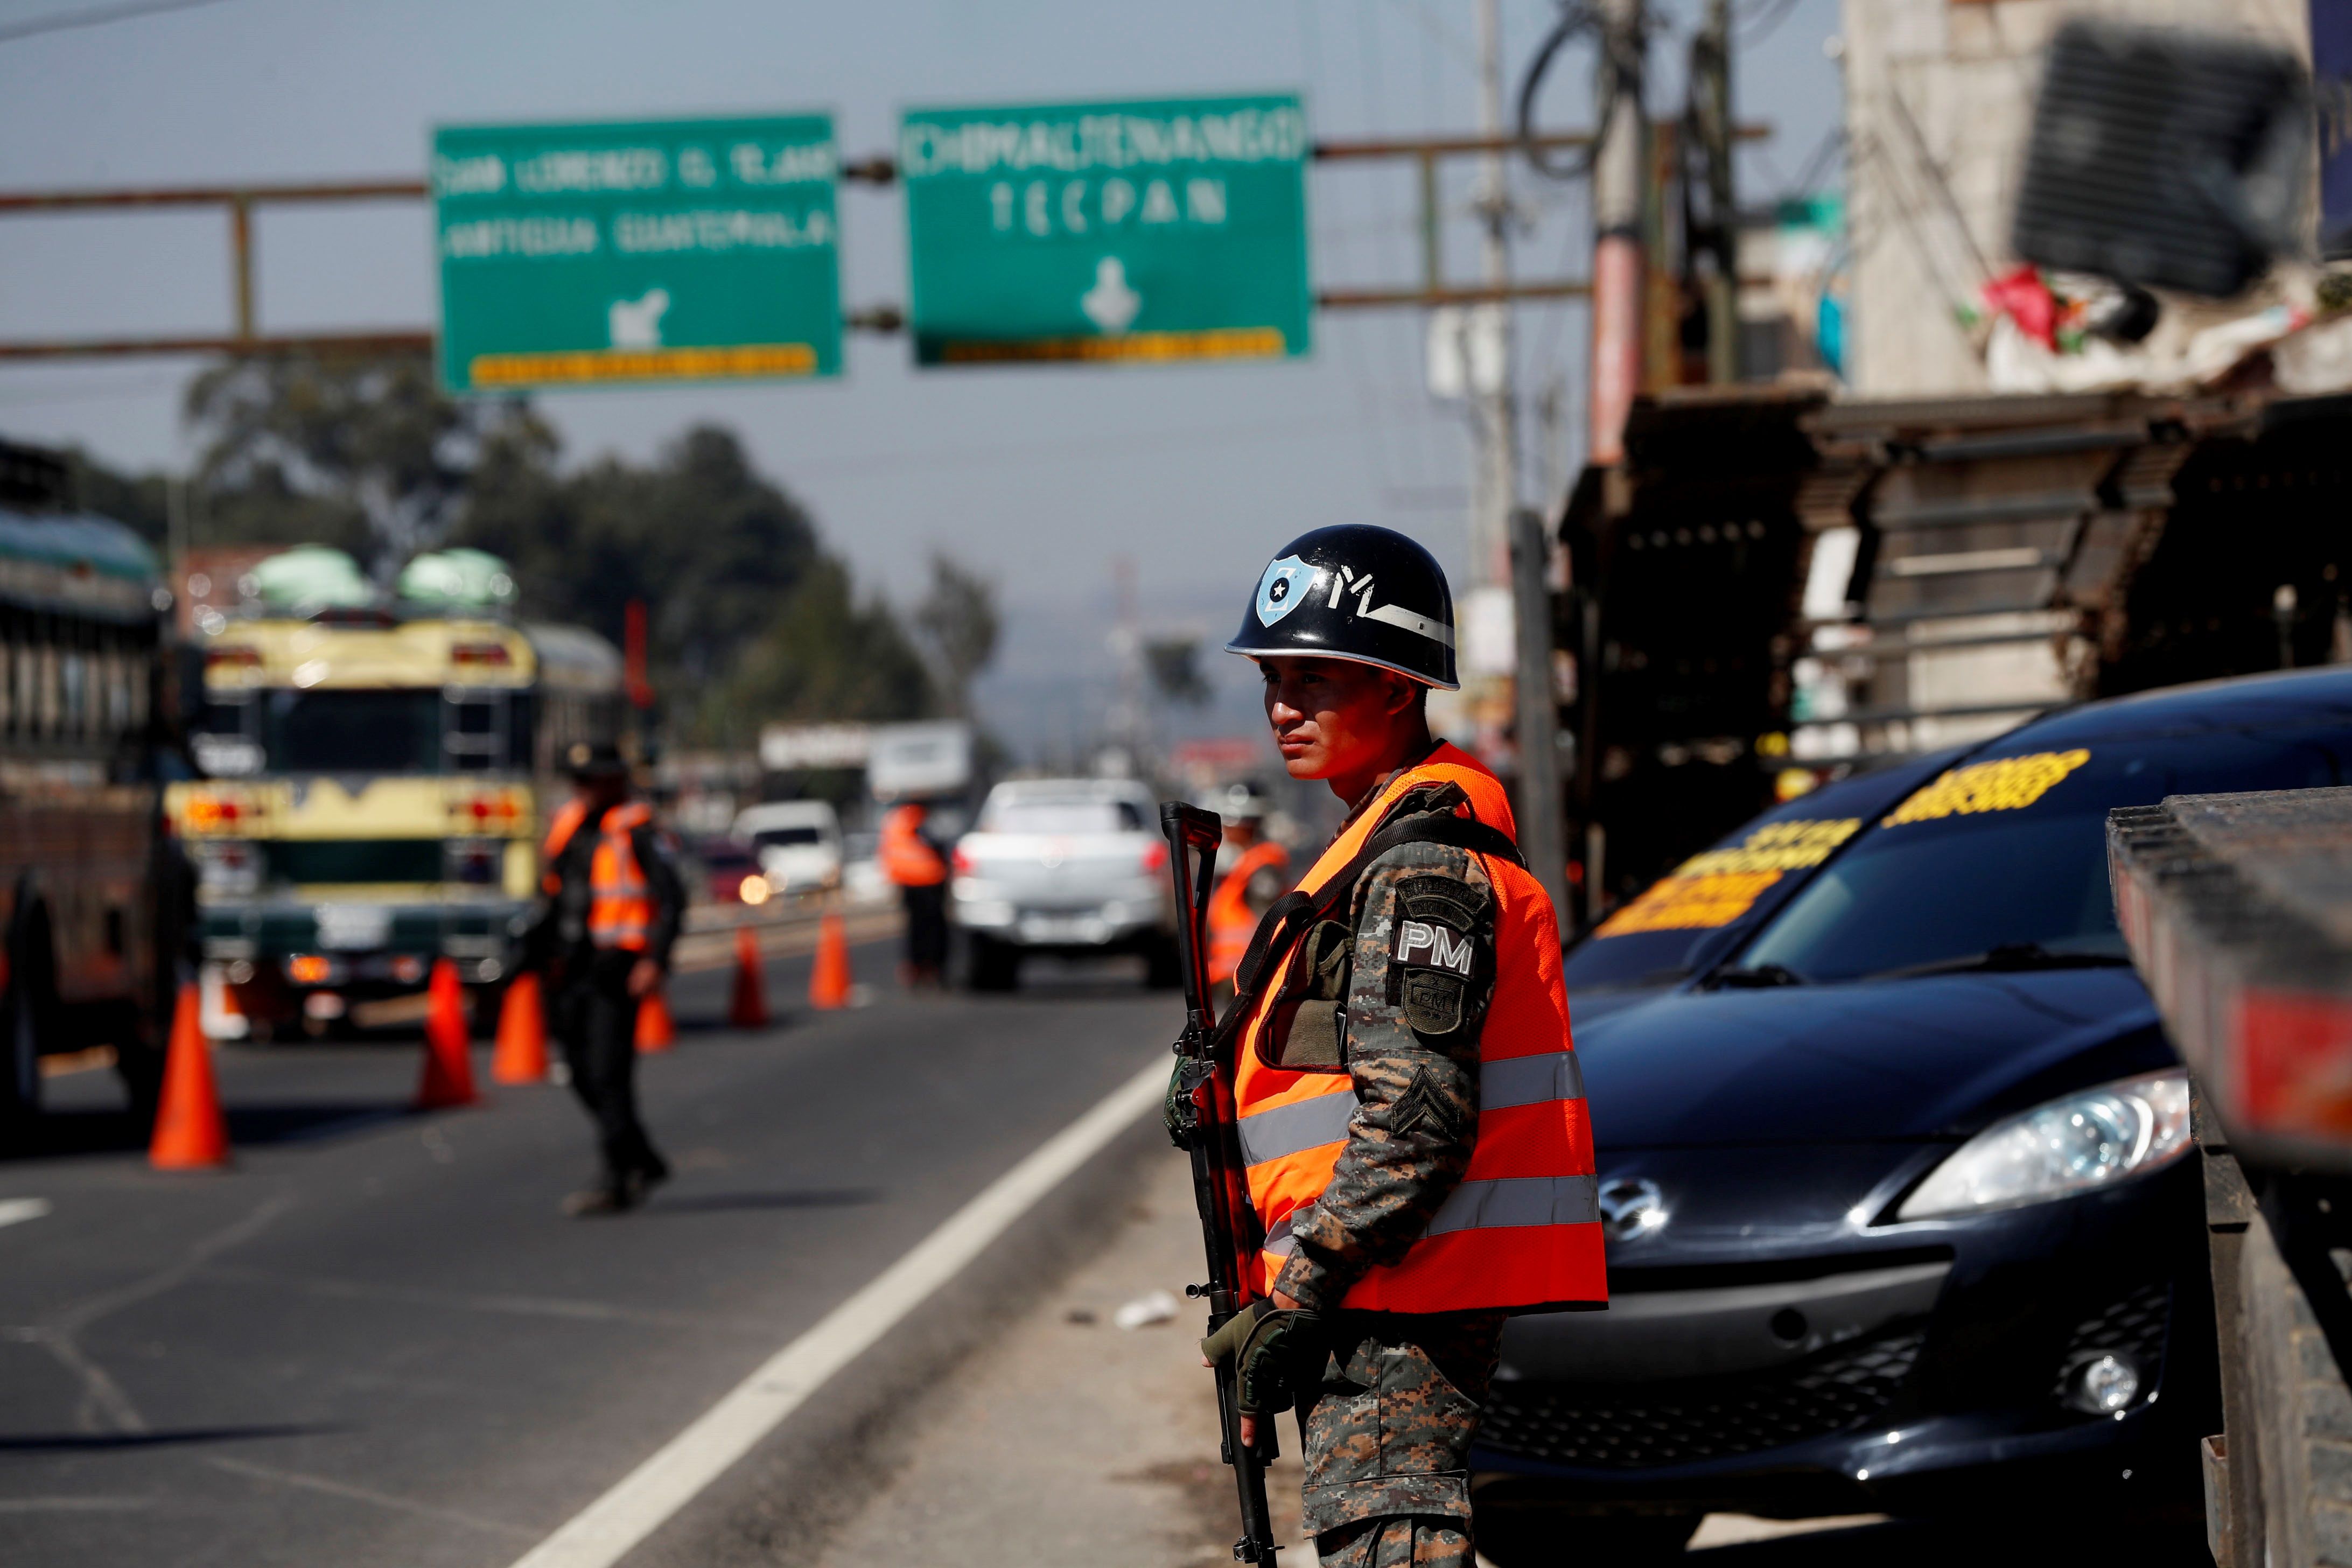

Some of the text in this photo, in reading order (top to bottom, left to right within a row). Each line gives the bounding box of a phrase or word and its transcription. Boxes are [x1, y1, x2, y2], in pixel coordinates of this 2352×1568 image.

[901, 109, 1305, 177] CHIMALTENANGO
[613, 209, 833, 252] GUATEMALA
[990, 177, 1228, 237] TECPAN
[1397, 920, 1475, 975] PM
[1419, 991, 1447, 1010] PM
